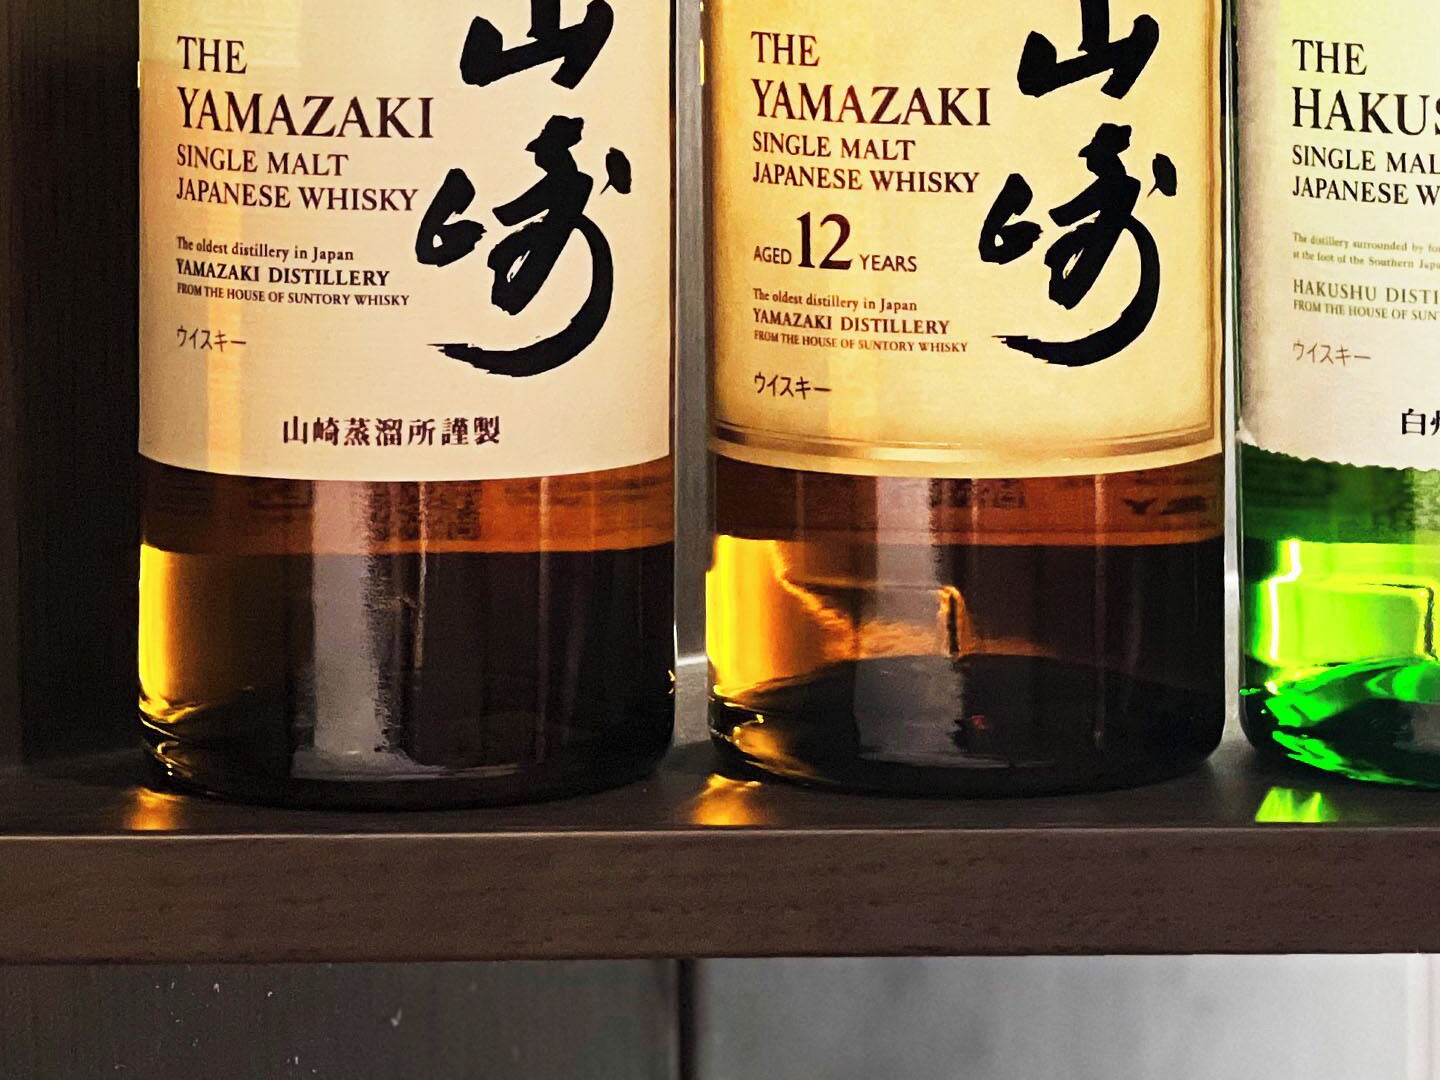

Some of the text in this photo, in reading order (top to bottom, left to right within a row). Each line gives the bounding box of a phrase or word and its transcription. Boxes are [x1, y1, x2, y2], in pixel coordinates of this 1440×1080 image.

[177, 36, 247, 75] THE
[751, 31, 820, 68] THE
[1292, 38, 1367, 76] THE
[177, 87, 434, 139] YAMAZAKI
[751, 78, 991, 127] YAMAZAKI
[752, 130, 916, 161] SINGLE MALT
[1292, 144, 1377, 173] SINGLE
[176, 144, 348, 177] SINGLE MALT
[752, 162, 980, 194] JAPANESE WHISKY
[1292, 175, 1409, 205] JAPANESE
[176, 178, 419, 211] JAPANESE WHISKY
[177, 236, 354, 264] The oldest distillery in Japan
[754, 211, 918, 272] AGED 12 YEARS
[1293, 232, 1307, 244] The
[1310, 235, 1349, 249] distillery
[1353, 239, 1408, 252] surrounded
[1411, 241, 1424, 254] by
[176, 258, 390, 286] YAMAZAKI DISTILLERY
[1293, 251, 1300, 260] at
[1302, 251, 1316, 262] the
[1317, 252, 1335, 263] foot
[1337, 254, 1347, 264] of
[1350, 255, 1364, 265] the
[1369, 257, 1415, 269] Southern
[177, 283, 410, 306] FROM THE HOUSE OF SUNTORY WHISKY
[753, 288, 917, 314] The oldest distillery in Japan
[1293, 279, 1377, 302] HAKUSHU
[753, 308, 950, 335] YAMAZAKI DISTILLERY
[1293, 299, 1321, 313] FROM
[1324, 303, 1345, 315] THE
[1349, 305, 1388, 319] HOUSE
[1391, 309, 1408, 320] OF
[177, 325, 247, 352] ウイスキー
[754, 330, 968, 353] FROM THE HOUSE OF SUNTORY WHISKY
[1292, 340, 1371, 366] ウイスキー
[754, 372, 832, 400] ウイスキー
